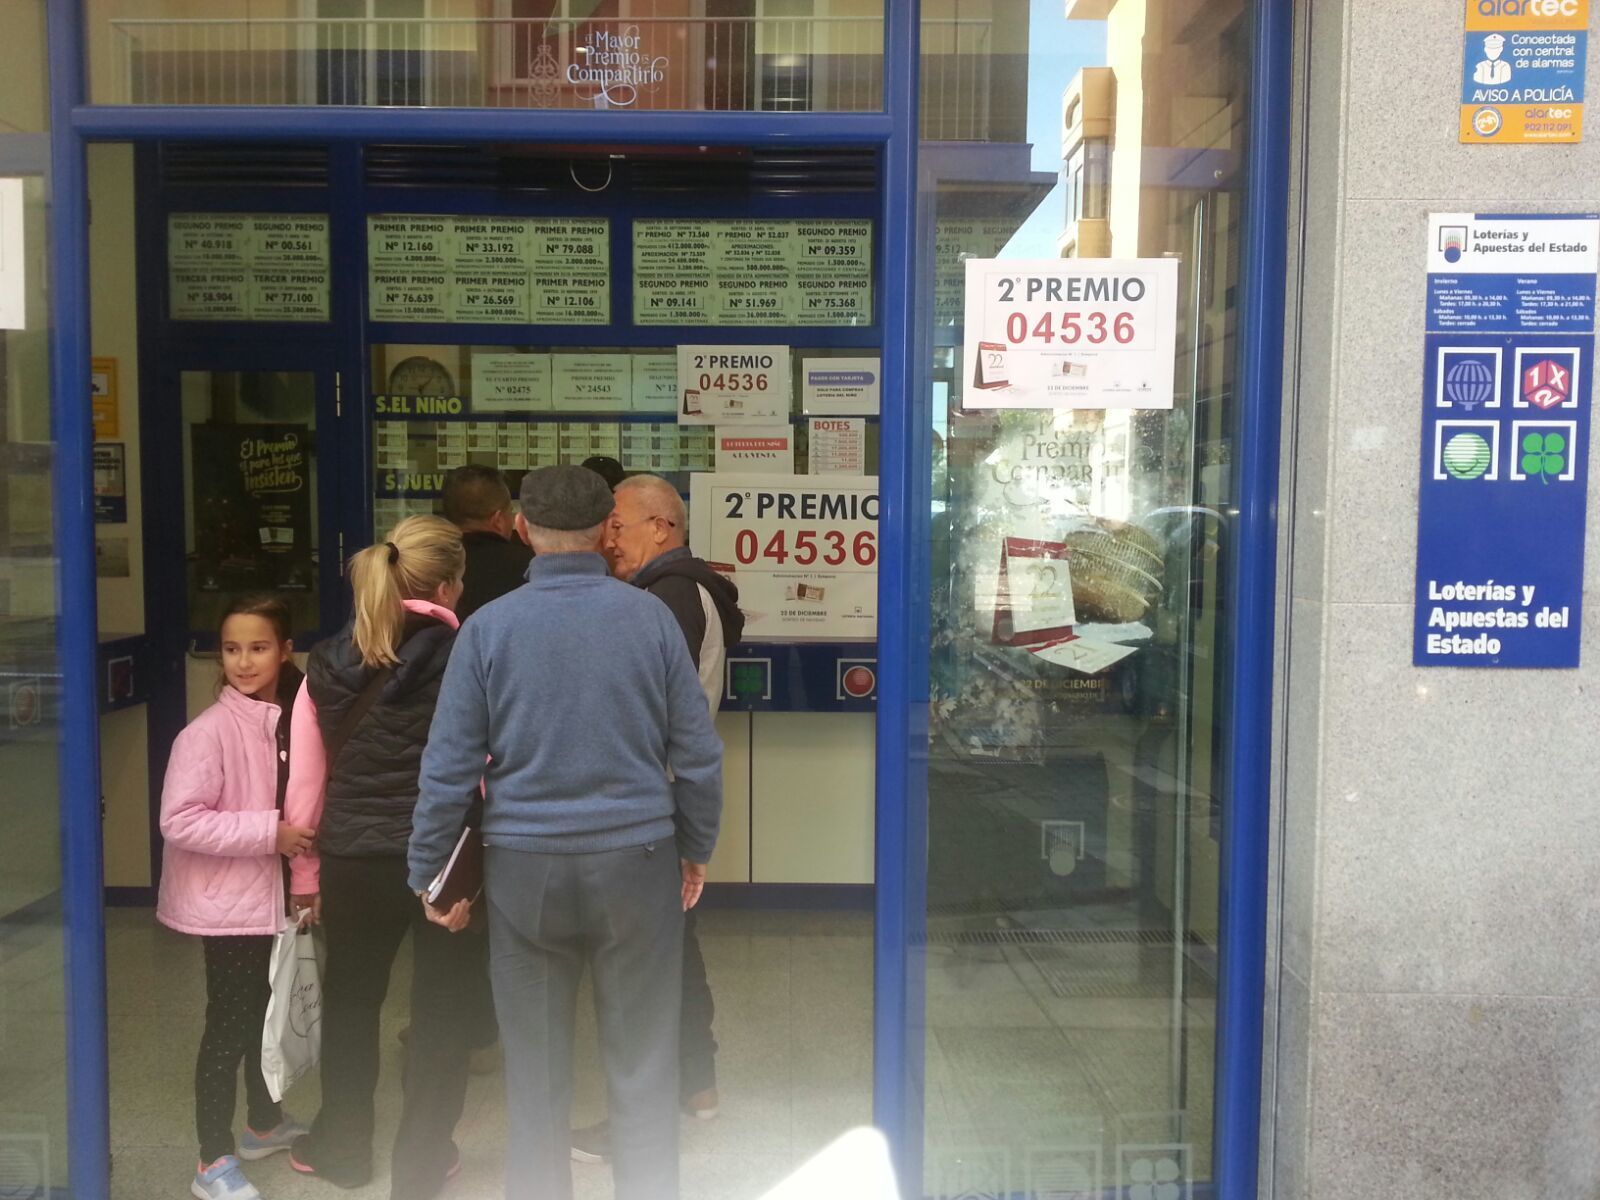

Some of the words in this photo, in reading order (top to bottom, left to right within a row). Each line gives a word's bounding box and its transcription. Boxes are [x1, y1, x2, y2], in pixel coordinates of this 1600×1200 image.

[596, 26, 640, 50] Mayor
[1512, 47, 1533, 57] con
[1535, 46, 1576, 57] central
[586, 46, 640, 68] Premio
[1515, 58, 1529, 68] de
[1531, 58, 1574, 68] alarmas
[1472, 89, 1508, 102] AVISO
[1511, 89, 1521, 102] A
[1524, 85, 1574, 102] POLICÍA
[1525, 108, 1573, 119] alartec
[1524, 123, 1542, 131] 902
[1543, 123, 1555, 131] 112
[1556, 123, 1572, 131] 091
[173, 222, 212, 230] SEGUNDO
[214, 222, 244, 230] PREMIO
[254, 223, 292, 231] SEGUNDO
[295, 223, 324, 231] PREMIO
[373, 223, 407, 232] PRIMER
[410, 224, 444, 232] PREMIO
[455, 225, 487, 233] PRIMER
[491, 225, 525, 233] PREMIO
[534, 226, 568, 235] PRIMER
[571, 226, 605, 235] PREMIO
[797, 228, 835, 236] SEGUNDO
[838, 228, 868, 236] PREMIO
[1473, 229, 1519, 240] Loterías
[1522, 231, 1529, 242] y
[281, 241, 312, 250] 00.561
[402, 241, 434, 251] 12.160
[482, 243, 514, 252] 33.192
[562, 244, 594, 254] 79.088
[824, 246, 856, 255] 09.359
[1473, 243, 1524, 255] Apuestas
[1528, 243, 1545, 253] del
[1549, 243, 1588, 253] Estado
[211, 275, 244, 283] PREMIO
[254, 275, 287, 283] TERCER
[291, 275, 325, 284] PREMIO
[375, 276, 408, 284] PRIMER
[411, 276, 445, 284] PREMIO
[456, 277, 489, 285] PRIMER
[492, 277, 525, 286] PREMIO
[536, 278, 569, 287] PRIMER
[572, 278, 606, 287] PREMIO
[639, 280, 677, 288] SEGUNDO
[679, 280, 709, 288] PREMIO
[1027, 278, 1146, 303] PREMIO
[281, 293, 314, 302] 77.100
[402, 293, 434, 303] 76.639
[483, 295, 514, 305] 26.569
[564, 296, 594, 306] 12.106
[666, 298, 696, 307] 09.141
[824, 298, 856, 307] 75.368
[745, 298, 777, 308] 51.969
[1006, 312, 1135, 344] 04536
[710, 355, 773, 370] PREMIO
[699, 373, 769, 391] 04536
[1529, 366, 1541, 387] 1
[1550, 364, 1566, 390] X
[507, 385, 531, 394] 02475
[588, 385, 611, 393] 24543
[1534, 388, 1561, 408] 2
[376, 395, 411, 414] S.EL
[415, 395, 463, 415] NIÑO
[814, 421, 851, 431] BOTES
[385, 474, 446, 491] S.JUEV
[757, 493, 879, 520] PREMIO
[735, 529, 877, 566] 04536
[1428, 579, 1516, 602] Loterías
[1522, 584, 1536, 606] y
[1428, 607, 1528, 632] Apuestas
[1534, 606, 1569, 628] del
[1427, 633, 1502, 655] Estado
